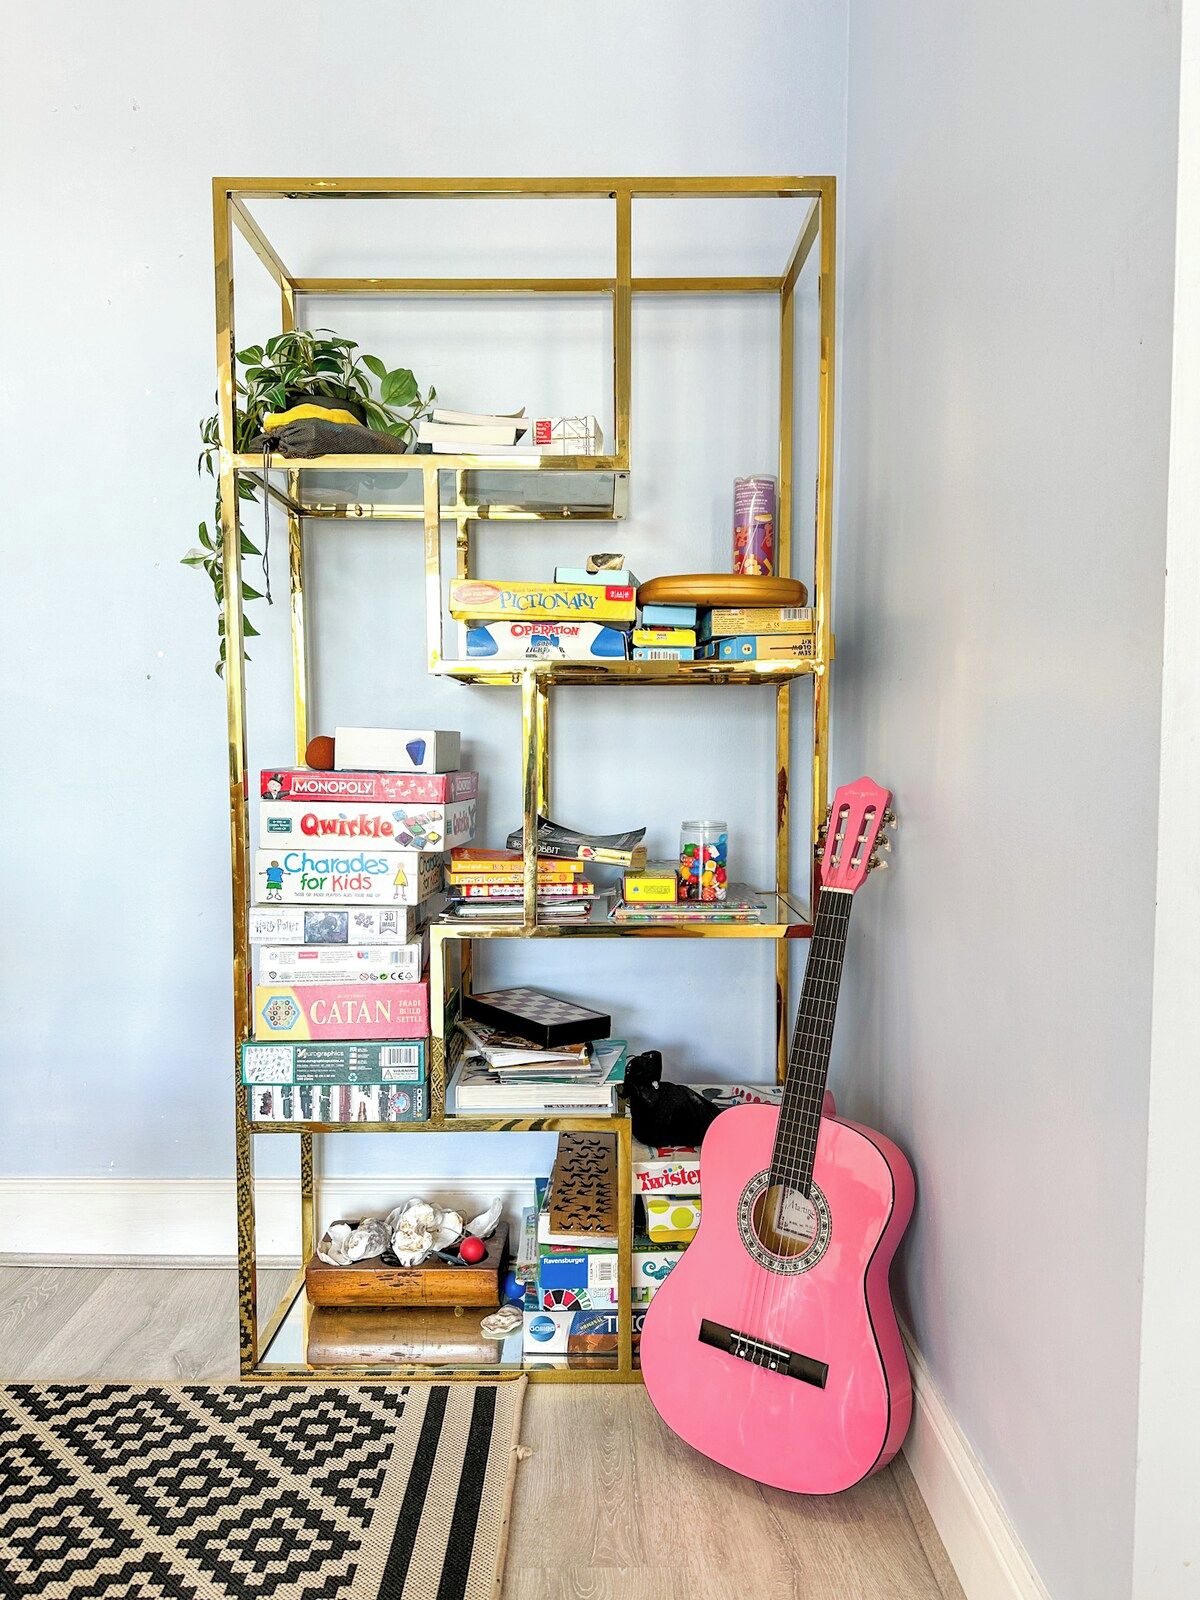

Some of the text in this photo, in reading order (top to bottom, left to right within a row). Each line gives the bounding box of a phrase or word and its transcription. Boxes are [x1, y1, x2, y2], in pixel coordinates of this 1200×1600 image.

[500, 591, 598, 611] PICTIONARY
[510, 624, 580, 637] OPERATION
[295, 780, 373, 794] MONOPOLY
[300, 812, 395, 838] Qwirkle
[284, 852, 389, 875] Charades
[300, 873, 372, 892] for Kids
[310, 1000, 391, 1025] CATAN
[543, 1257, 585, 1265] Ravensburger
